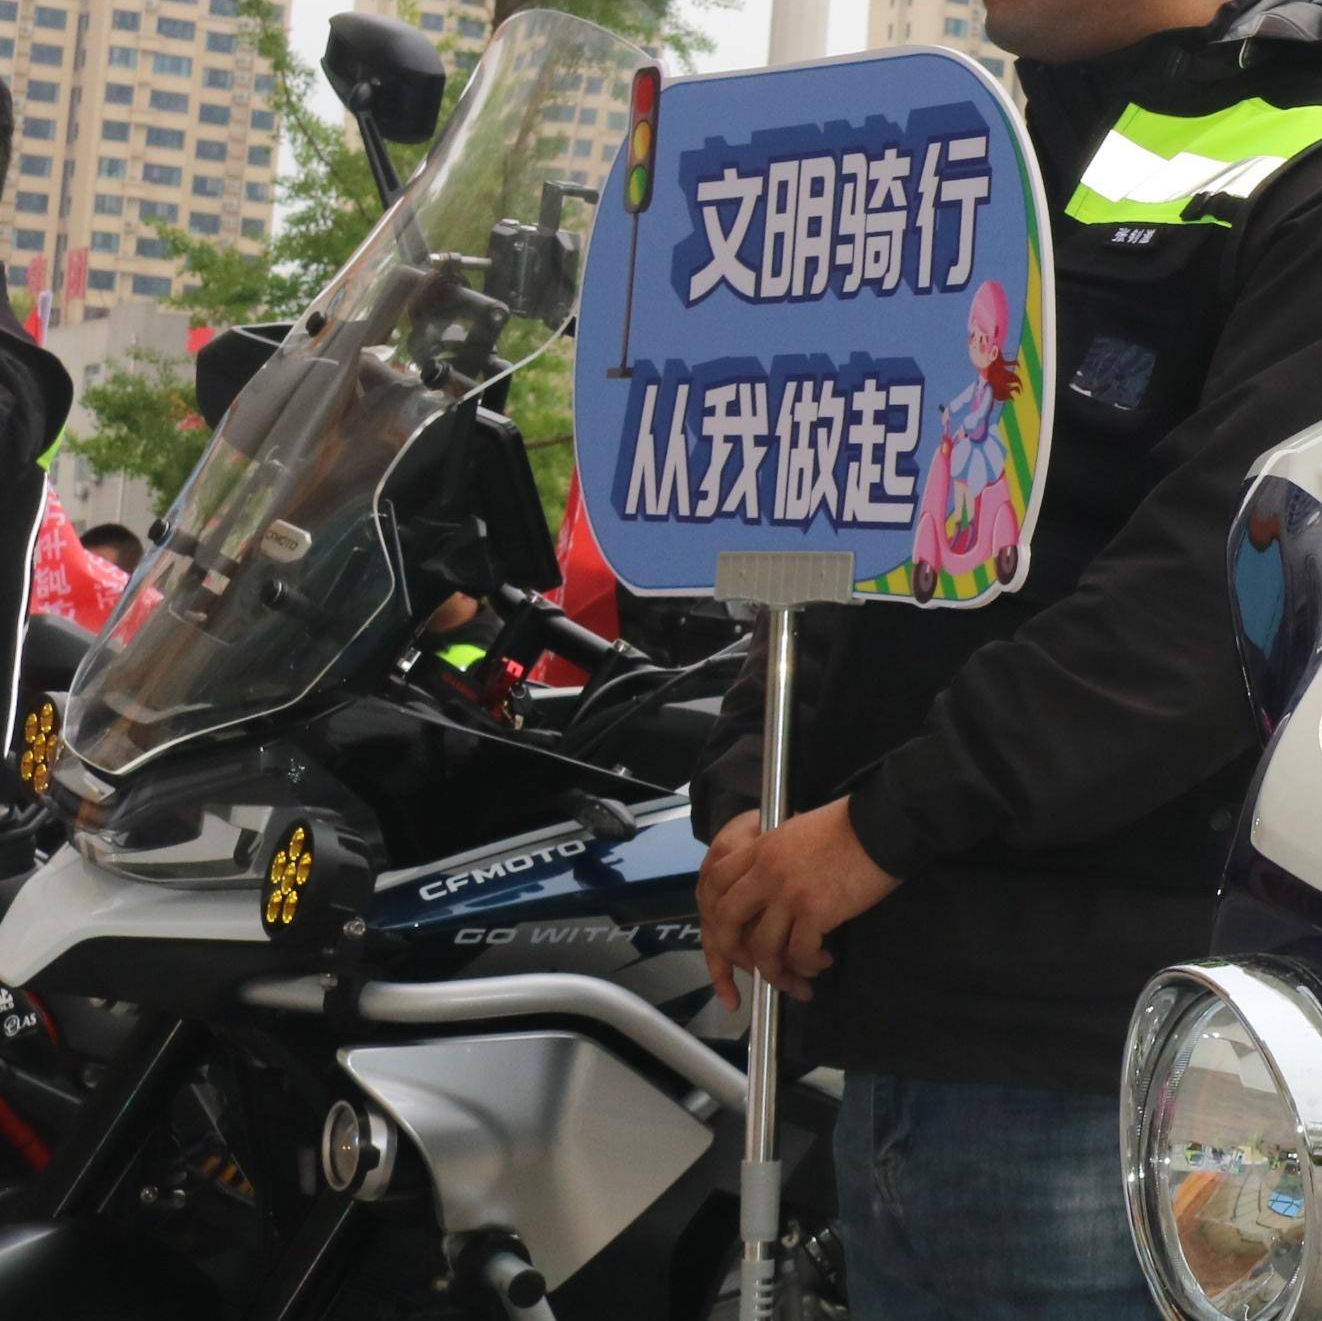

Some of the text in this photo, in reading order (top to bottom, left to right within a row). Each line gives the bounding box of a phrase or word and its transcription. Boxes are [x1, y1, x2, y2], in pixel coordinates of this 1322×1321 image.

[689, 134, 990, 302] 文明骑行
[625, 378, 923, 522] 从我做起
[419, 839, 586, 901] CFMOTO
[453, 923, 703, 945] GO WITH TH
